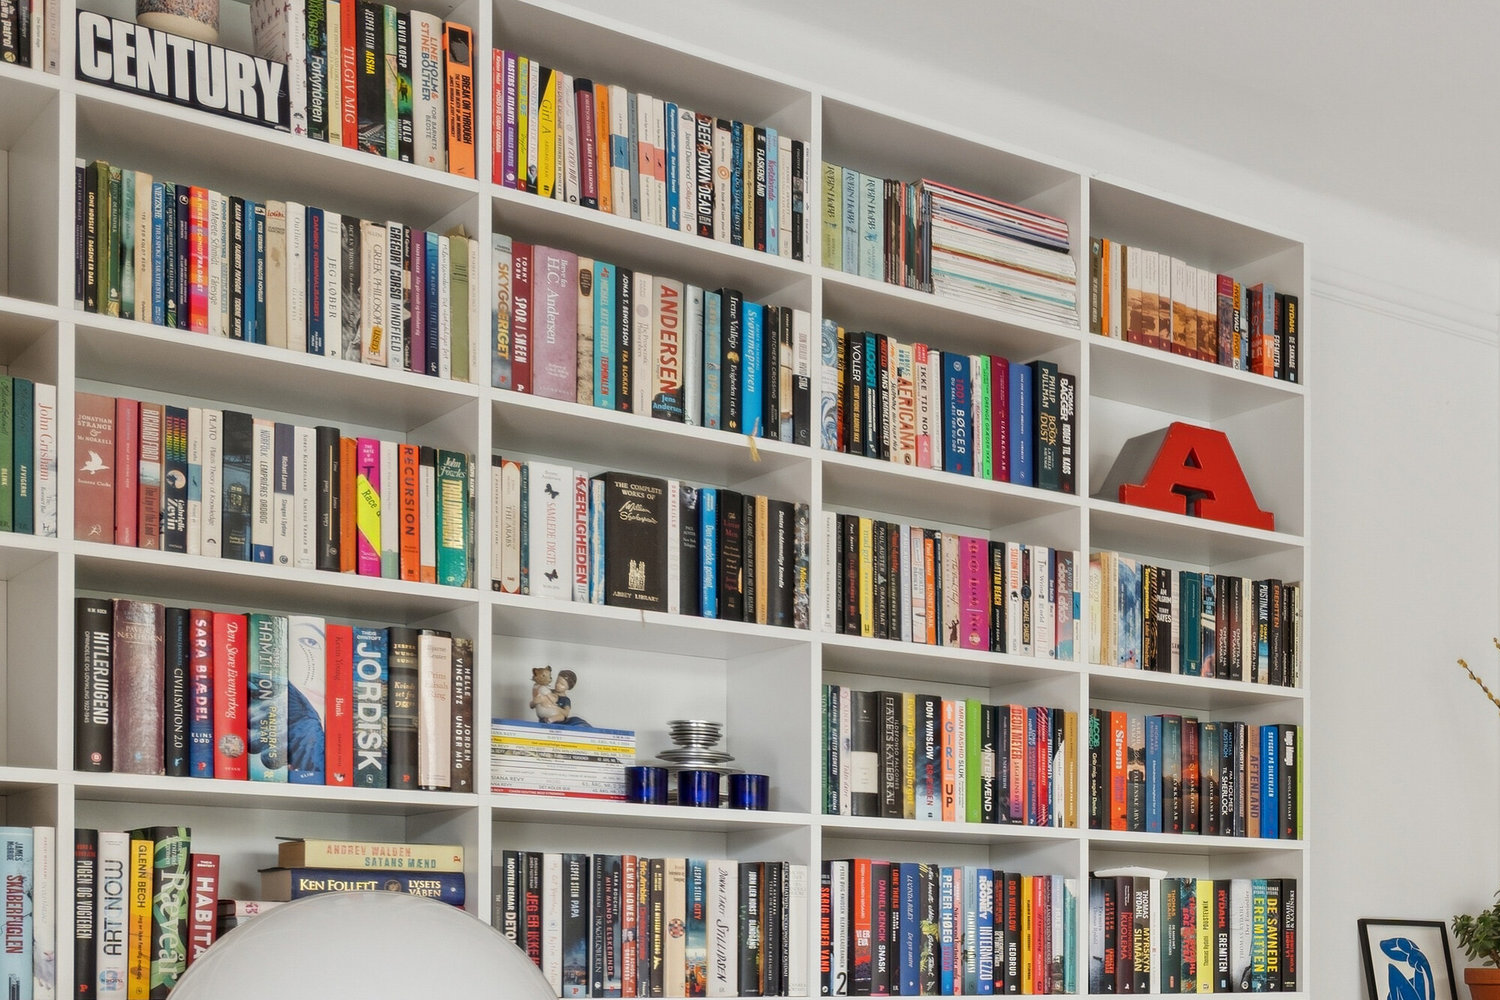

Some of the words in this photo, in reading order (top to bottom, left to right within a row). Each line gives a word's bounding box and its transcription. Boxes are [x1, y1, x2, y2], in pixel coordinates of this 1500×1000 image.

[365, 9, 374, 31] JESPER
[365, 32, 375, 50] STEIN
[79, 11, 284, 124] CENTURY
[343, 46, 356, 94] TILGIV
[366, 51, 376, 75] AISHA
[310, 56, 325, 123] Forkynderen
[462, 75, 472, 99] BREAK
[344, 97, 356, 124] MIG
[462, 101, 472, 112] ON
[541, 99, 553, 121] Girl
[463, 112, 472, 145] THROUGH
[542, 126, 552, 134] A
[698, 120, 712, 146] DEEP
[698, 151, 713, 184] DOWN
[756, 148, 764, 181] FLASKENS
[684, 180, 692, 210] Collapse
[698, 186, 712, 214] DEAD
[757, 182, 767, 197] ÅND
[390, 226, 402, 269] GREGORY
[328, 257, 338, 278] JEG
[548, 256, 560, 284] H.C.
[328, 281, 338, 320] LØBER
[390, 269, 402, 300] CORSO
[496, 262, 510, 360] SKYGGERIGET
[514, 296, 526, 322] SPOR
[546, 287, 560, 344] Andersen
[730, 296, 738, 319] Irene
[370, 329, 380, 350] USED
[391, 302, 402, 352] MINDFIELD
[660, 284, 678, 395] ANDERSEN
[728, 320, 738, 348] Vallejo
[514, 332, 527, 363] SNEEN
[744, 310, 756, 392] Svømmeprøven
[852, 345, 862, 382] VOLLER
[38, 403, 53, 431] John
[142, 408, 160, 441] RICHARD
[208, 414, 216, 440] PLATO
[897, 376, 914, 450] AFRICANA
[957, 409, 966, 454] BØGER
[40, 433, 53, 481] Grisham
[142, 441, 160, 462] FORD
[361, 489, 378, 509] Race
[404, 447, 416, 536] RECURSION
[167, 498, 178, 530] Zevin
[177, 500, 185, 532] Gabrielle
[546, 502, 556, 538] SAMLEDE
[576, 476, 588, 584] KÆRLIGHEDEN
[546, 541, 556, 566] DIGTE
[994, 549, 1002, 585] MANHATTAN
[994, 585, 1002, 606] BEACH
[1260, 584, 1268, 621] PUSTINJAK
[195, 619, 207, 658] SARA
[258, 620, 272, 700] HAMILTON
[92, 631, 110, 725] HITLERJUGEND
[196, 664, 208, 722] BLÆDEL
[174, 668, 184, 733] CIVILISATION
[336, 697, 344, 717] Bunk
[356, 642, 382, 771] JORDISK
[925, 701, 934, 718] DON
[174, 734, 183, 748] 2.0
[926, 720, 934, 760] WINSLOW
[1115, 730, 1124, 770] Strøm
[984, 742, 992, 812] VINTERMÆND
[1250, 756, 1259, 818] AFTENLAND
[138, 844, 147, 878] GLENN
[326, 844, 366, 855] ANDREV
[371, 846, 412, 857] WALDEN
[364, 856, 403, 868] SATANS
[408, 858, 437, 869] MÆND
[76, 860, 92, 884] PIGEN
[300, 878, 324, 891] KEN
[328, 880, 378, 891] FOLLETT
[571, 861, 580, 881] JESPER
[76, 887, 92, 898] OG
[136, 881, 146, 908] BECH
[571, 882, 580, 898] STEIN
[942, 874, 952, 910] PETER
[1267, 898, 1278, 914] DE
[5, 874, 24, 954] SKABERFUGLEN
[76, 900, 92, 939] VOGTEREN
[158, 870, 188, 980] Ræveår
[571, 900, 580, 918] PAPA
[942, 912, 953, 943] HØEG
[1254, 897, 1265, 973] EREMITTEN
[716, 918, 730, 983] STILLIDSEN
[878, 944, 886, 973] SNASK
[980, 926, 993, 980] INTERMEZZO
[1267, 918, 1278, 973] SAVNEDE
